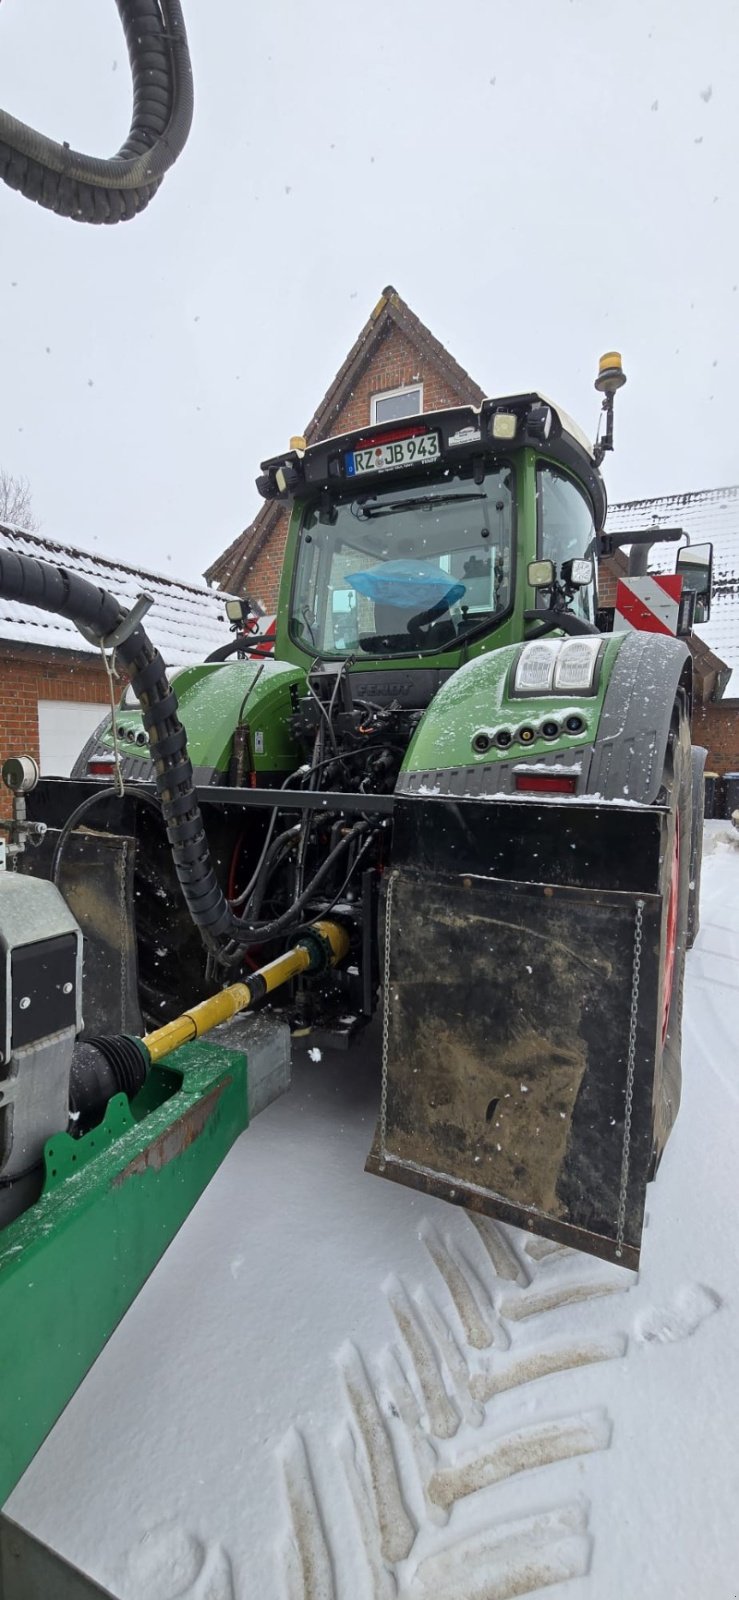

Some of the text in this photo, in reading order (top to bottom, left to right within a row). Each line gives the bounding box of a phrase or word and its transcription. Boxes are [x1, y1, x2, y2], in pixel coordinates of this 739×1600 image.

[355, 451, 375, 472] RZ
[385, 445, 404, 464] JB
[407, 436, 437, 460] 943
[358, 683, 413, 697] FENDT
